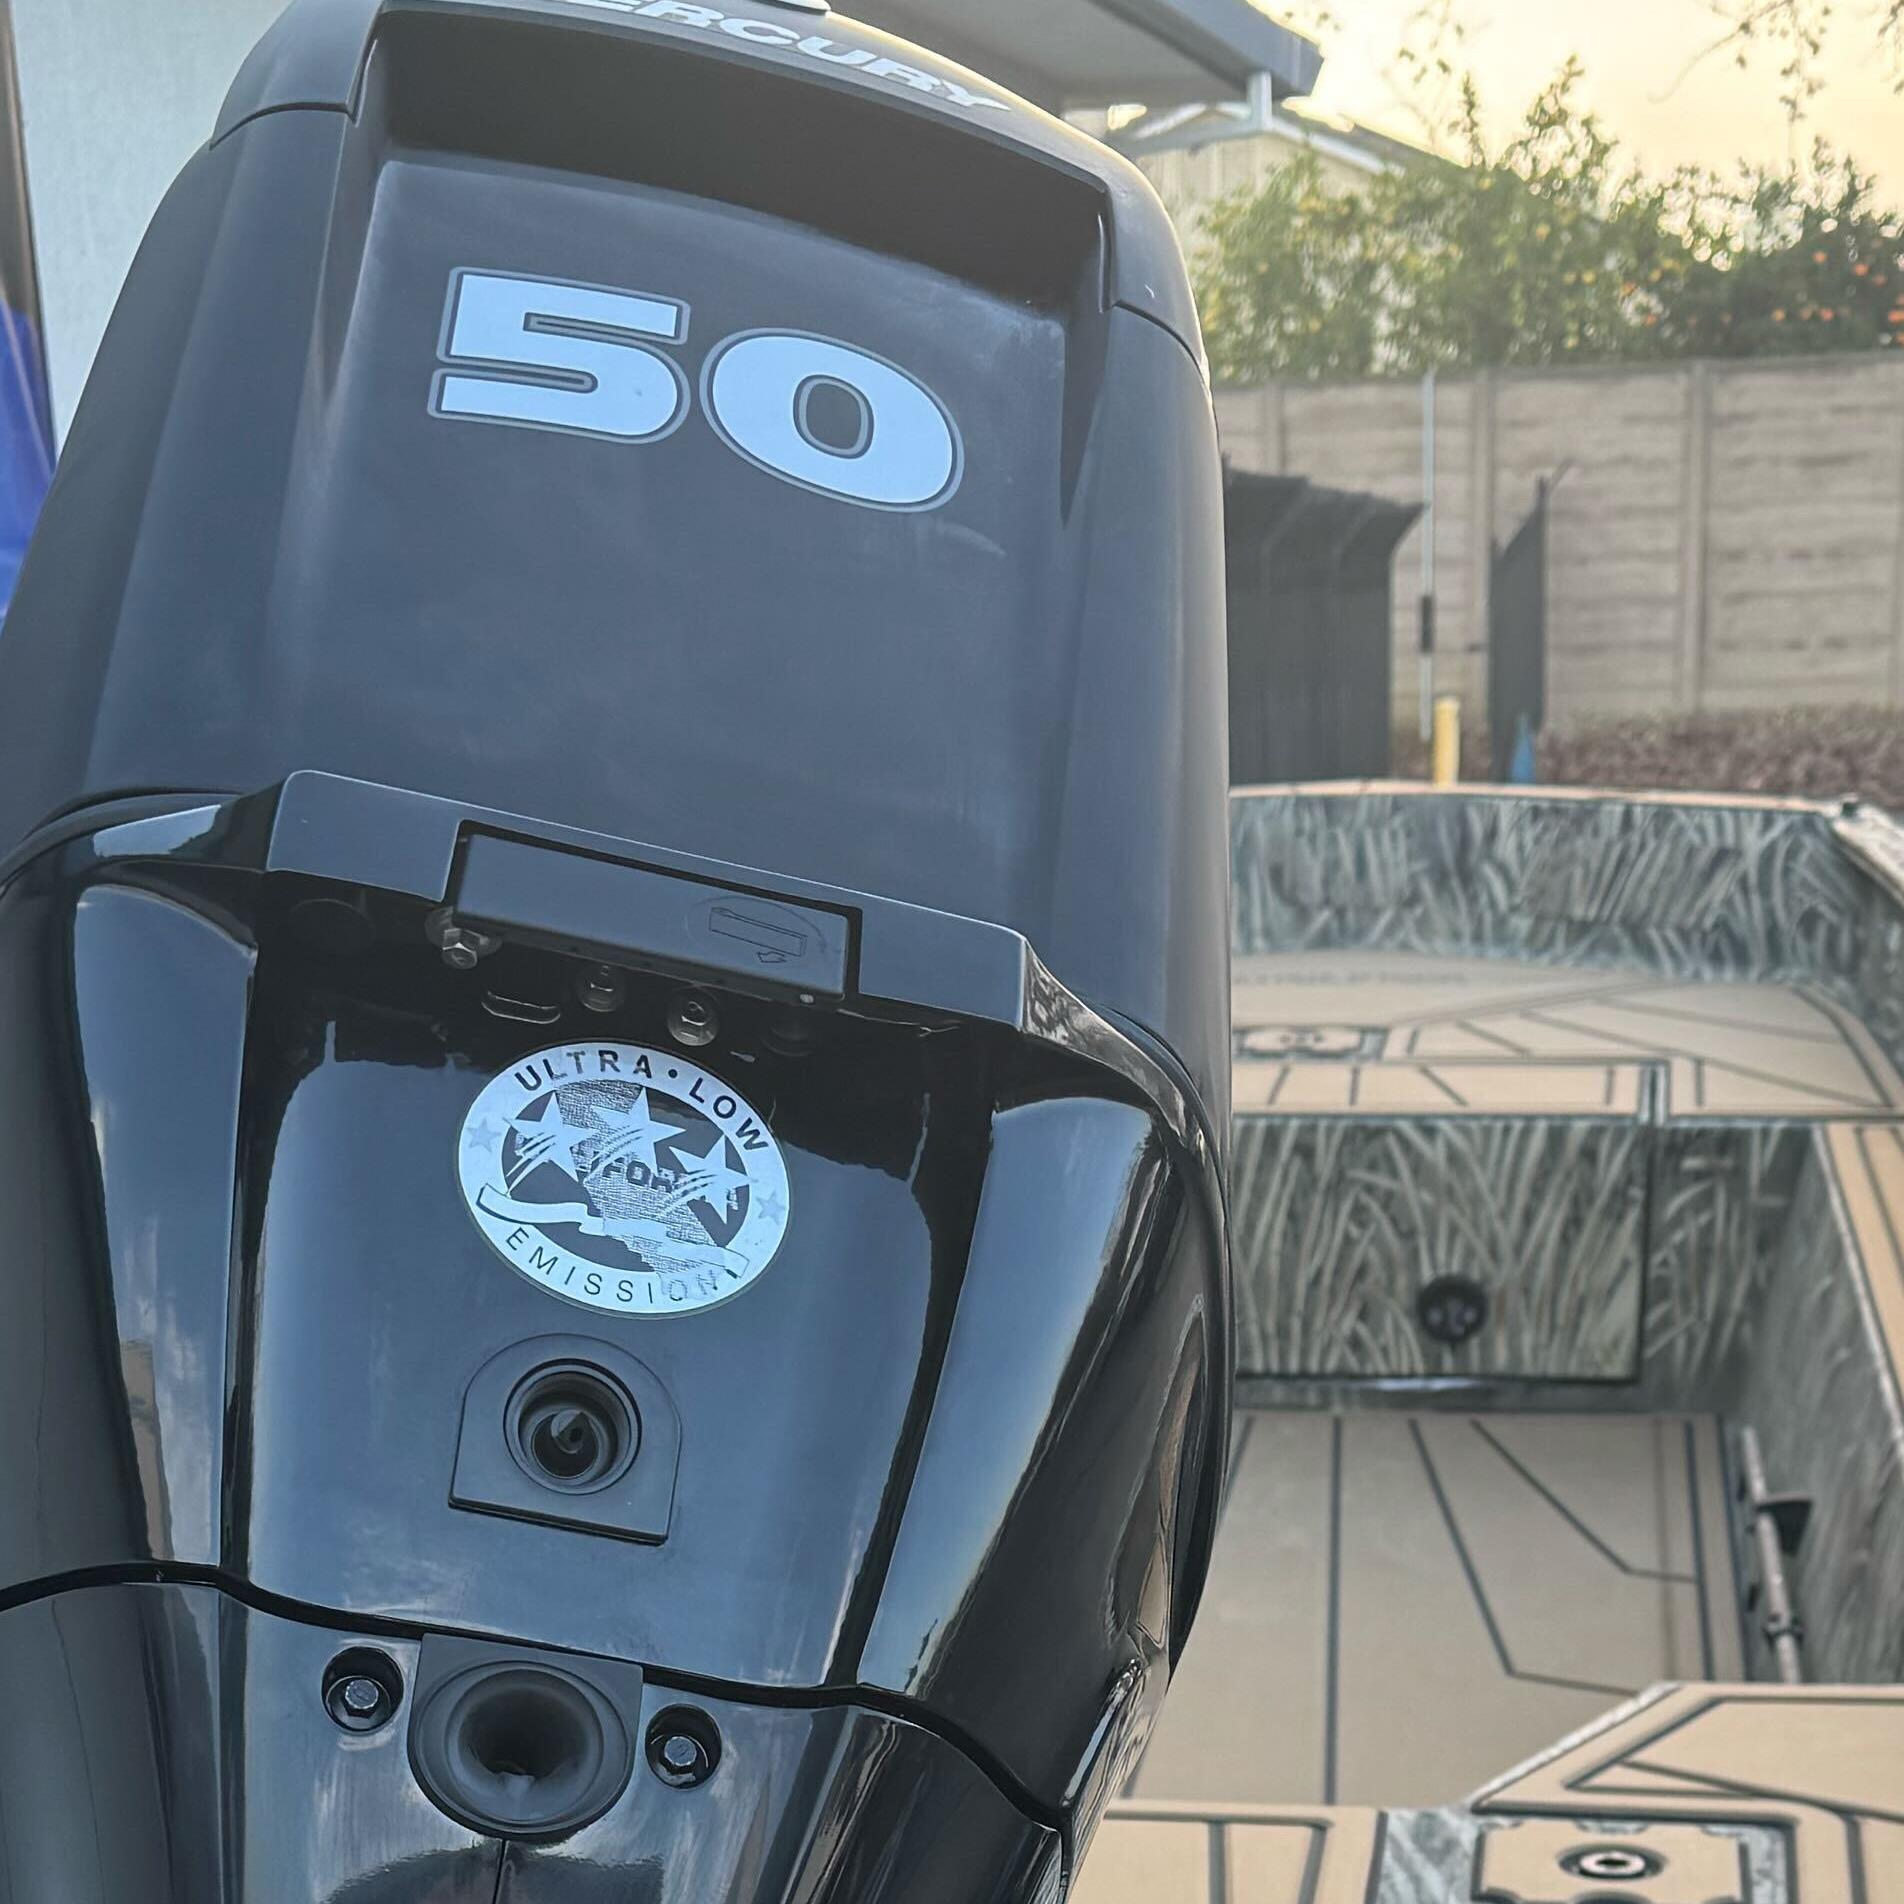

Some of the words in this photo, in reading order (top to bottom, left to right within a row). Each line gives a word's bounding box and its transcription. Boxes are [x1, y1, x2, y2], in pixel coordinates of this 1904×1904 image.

[428, 266, 964, 513] 50
[514, 1047, 653, 1093] ULTRA
[688, 1076, 770, 1152] LOW
[505, 1227, 720, 1304] EMISSION
